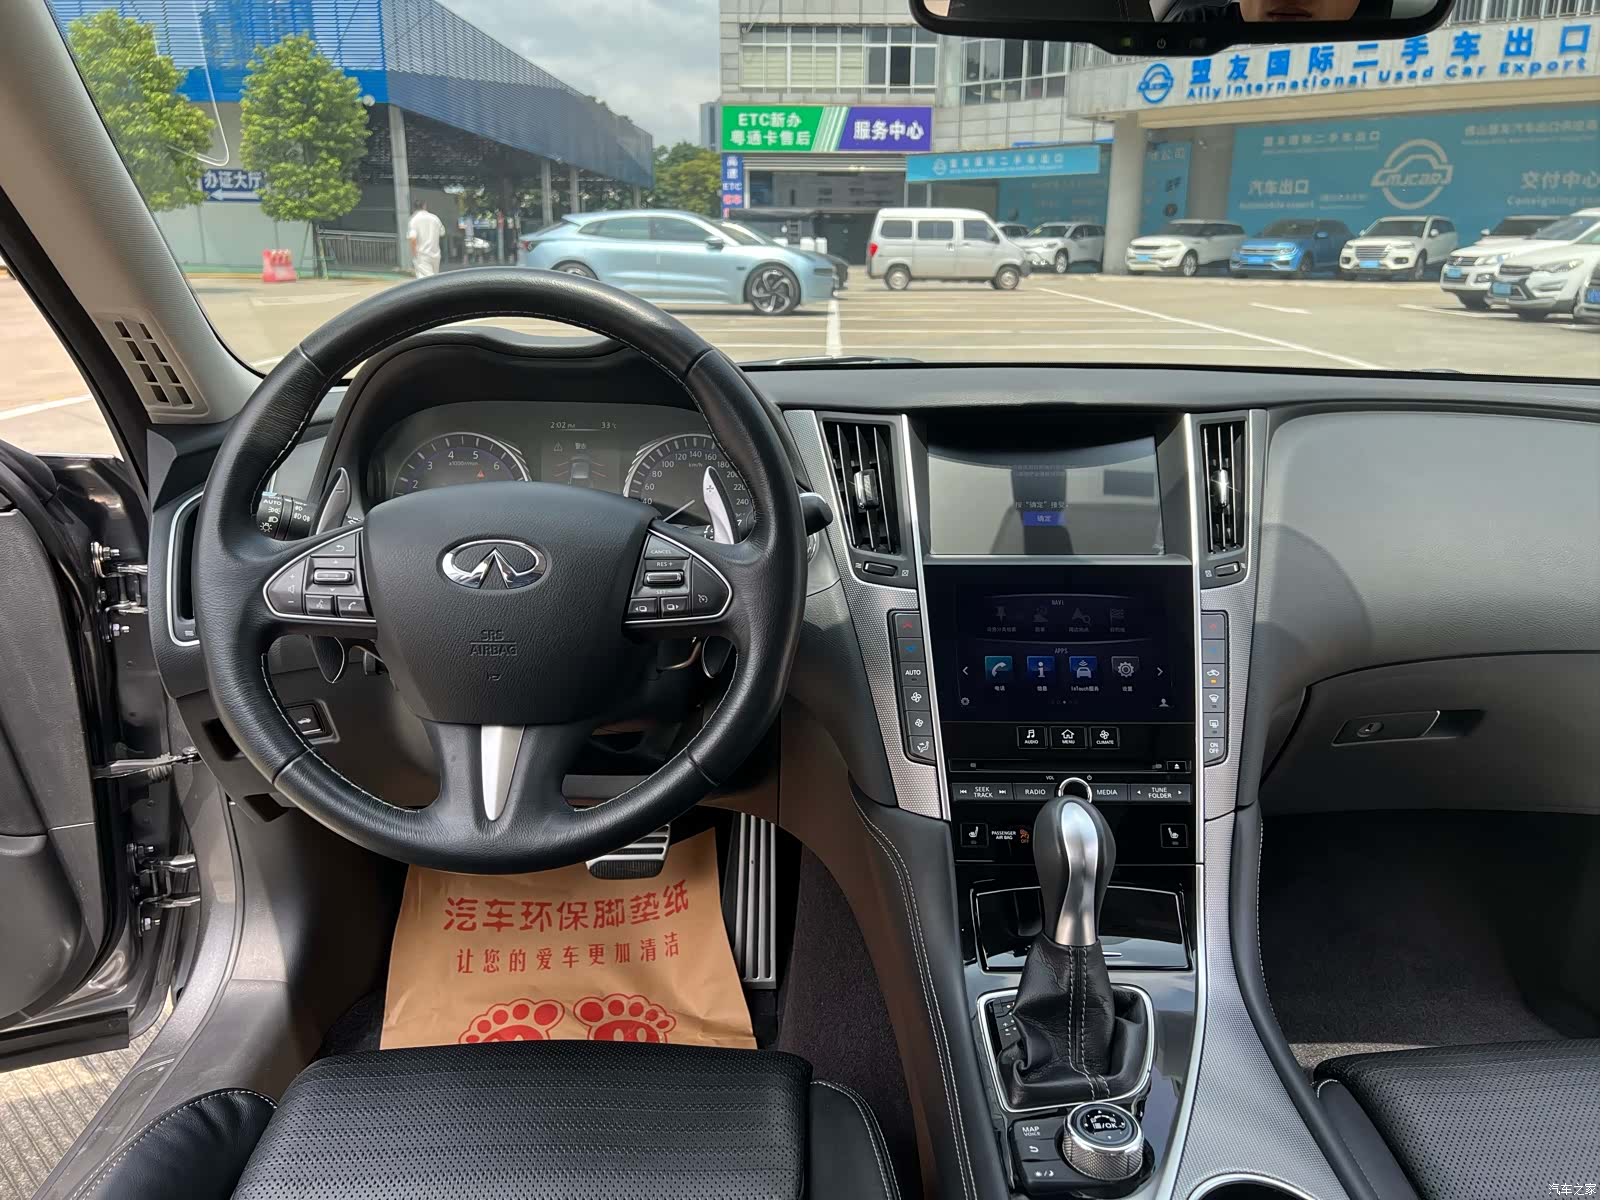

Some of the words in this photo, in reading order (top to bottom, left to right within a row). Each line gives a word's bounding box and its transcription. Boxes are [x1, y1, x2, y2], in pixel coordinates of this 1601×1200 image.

[1190, 25, 1592, 84] 盟友国际二手车出口
[1187, 85, 1221, 101] Ally
[1226, 71, 1365, 96] International
[1378, 66, 1434, 83] Used
[1446, 64, 1486, 78] Car
[1499, 57, 1587, 76] Export
[738, 113, 802, 127] ETC新办
[852, 121, 922, 141] 服务中心
[204, 170, 262, 189] 办证大厅
[1521, 169, 1599, 189] 交付中心
[1248, 179, 1310, 196] 汽车出口
[448, 451, 455, 459] 4
[473, 451, 479, 459] 5
[427, 462, 433, 470] 3
[494, 461, 500, 470] 6
[412, 481, 419, 489] 2
[480, 629, 505, 642] SRS
[470, 644, 518, 657] AIRBAG
[1024, 788, 1046, 796] RADIO
[443, 880, 689, 932] 汽车环保脚垫纸
[456, 932, 680, 974] 让您的爱车更加清洁
